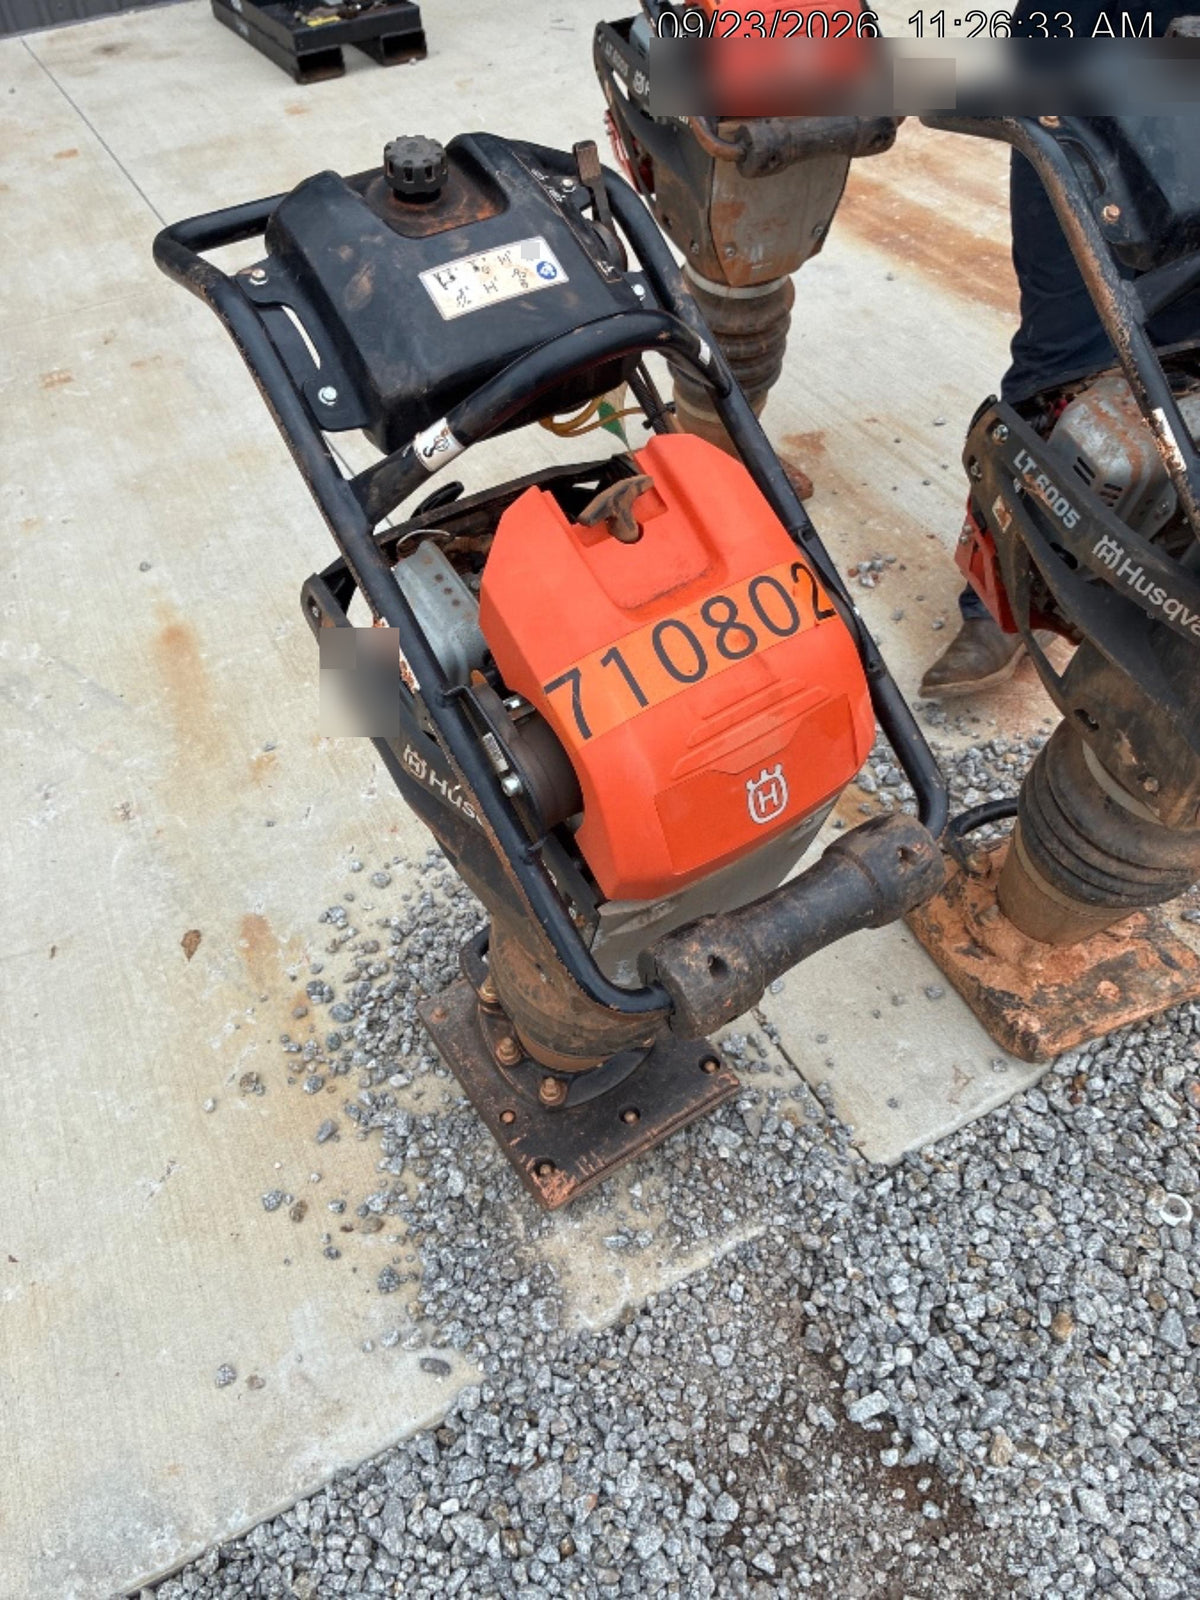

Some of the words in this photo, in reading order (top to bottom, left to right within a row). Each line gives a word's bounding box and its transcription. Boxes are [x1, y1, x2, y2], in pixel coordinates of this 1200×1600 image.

[1013, 448, 1037, 475] LT
[1036, 474, 1081, 529] 6005
[543, 561, 837, 740] 710802
[429, 769, 482, 825] Hus
